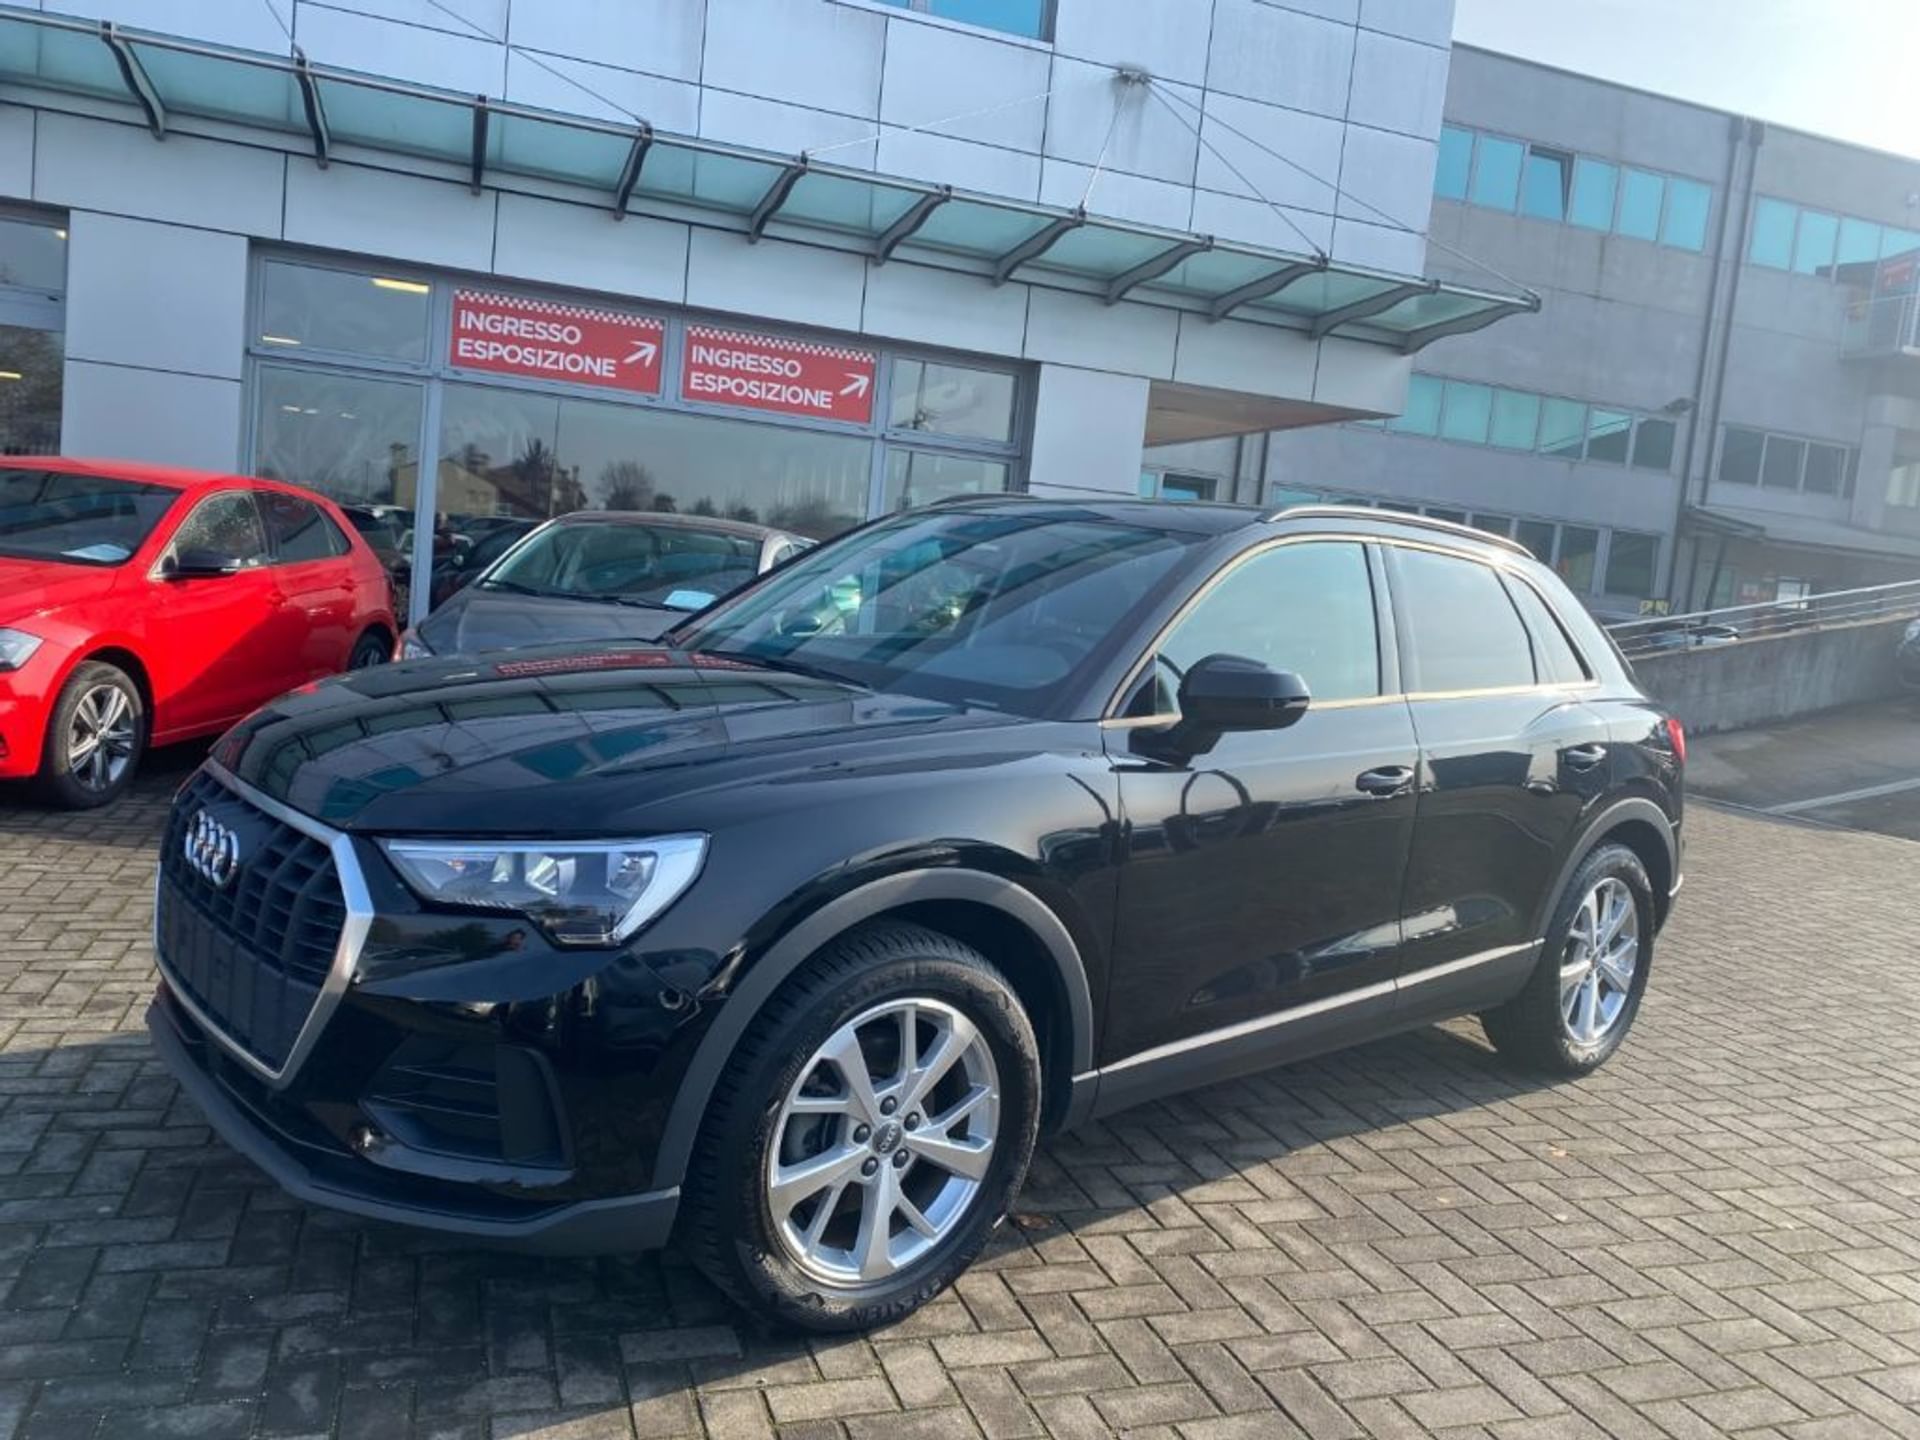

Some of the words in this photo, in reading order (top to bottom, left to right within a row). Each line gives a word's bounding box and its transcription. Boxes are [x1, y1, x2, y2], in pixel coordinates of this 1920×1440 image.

[460, 310, 581, 345] INGRESSO
[458, 338, 616, 378] ESPOSIZIONE
[692, 346, 801, 378] INGRESSO
[690, 372, 832, 409] ESPOSIZIONE
